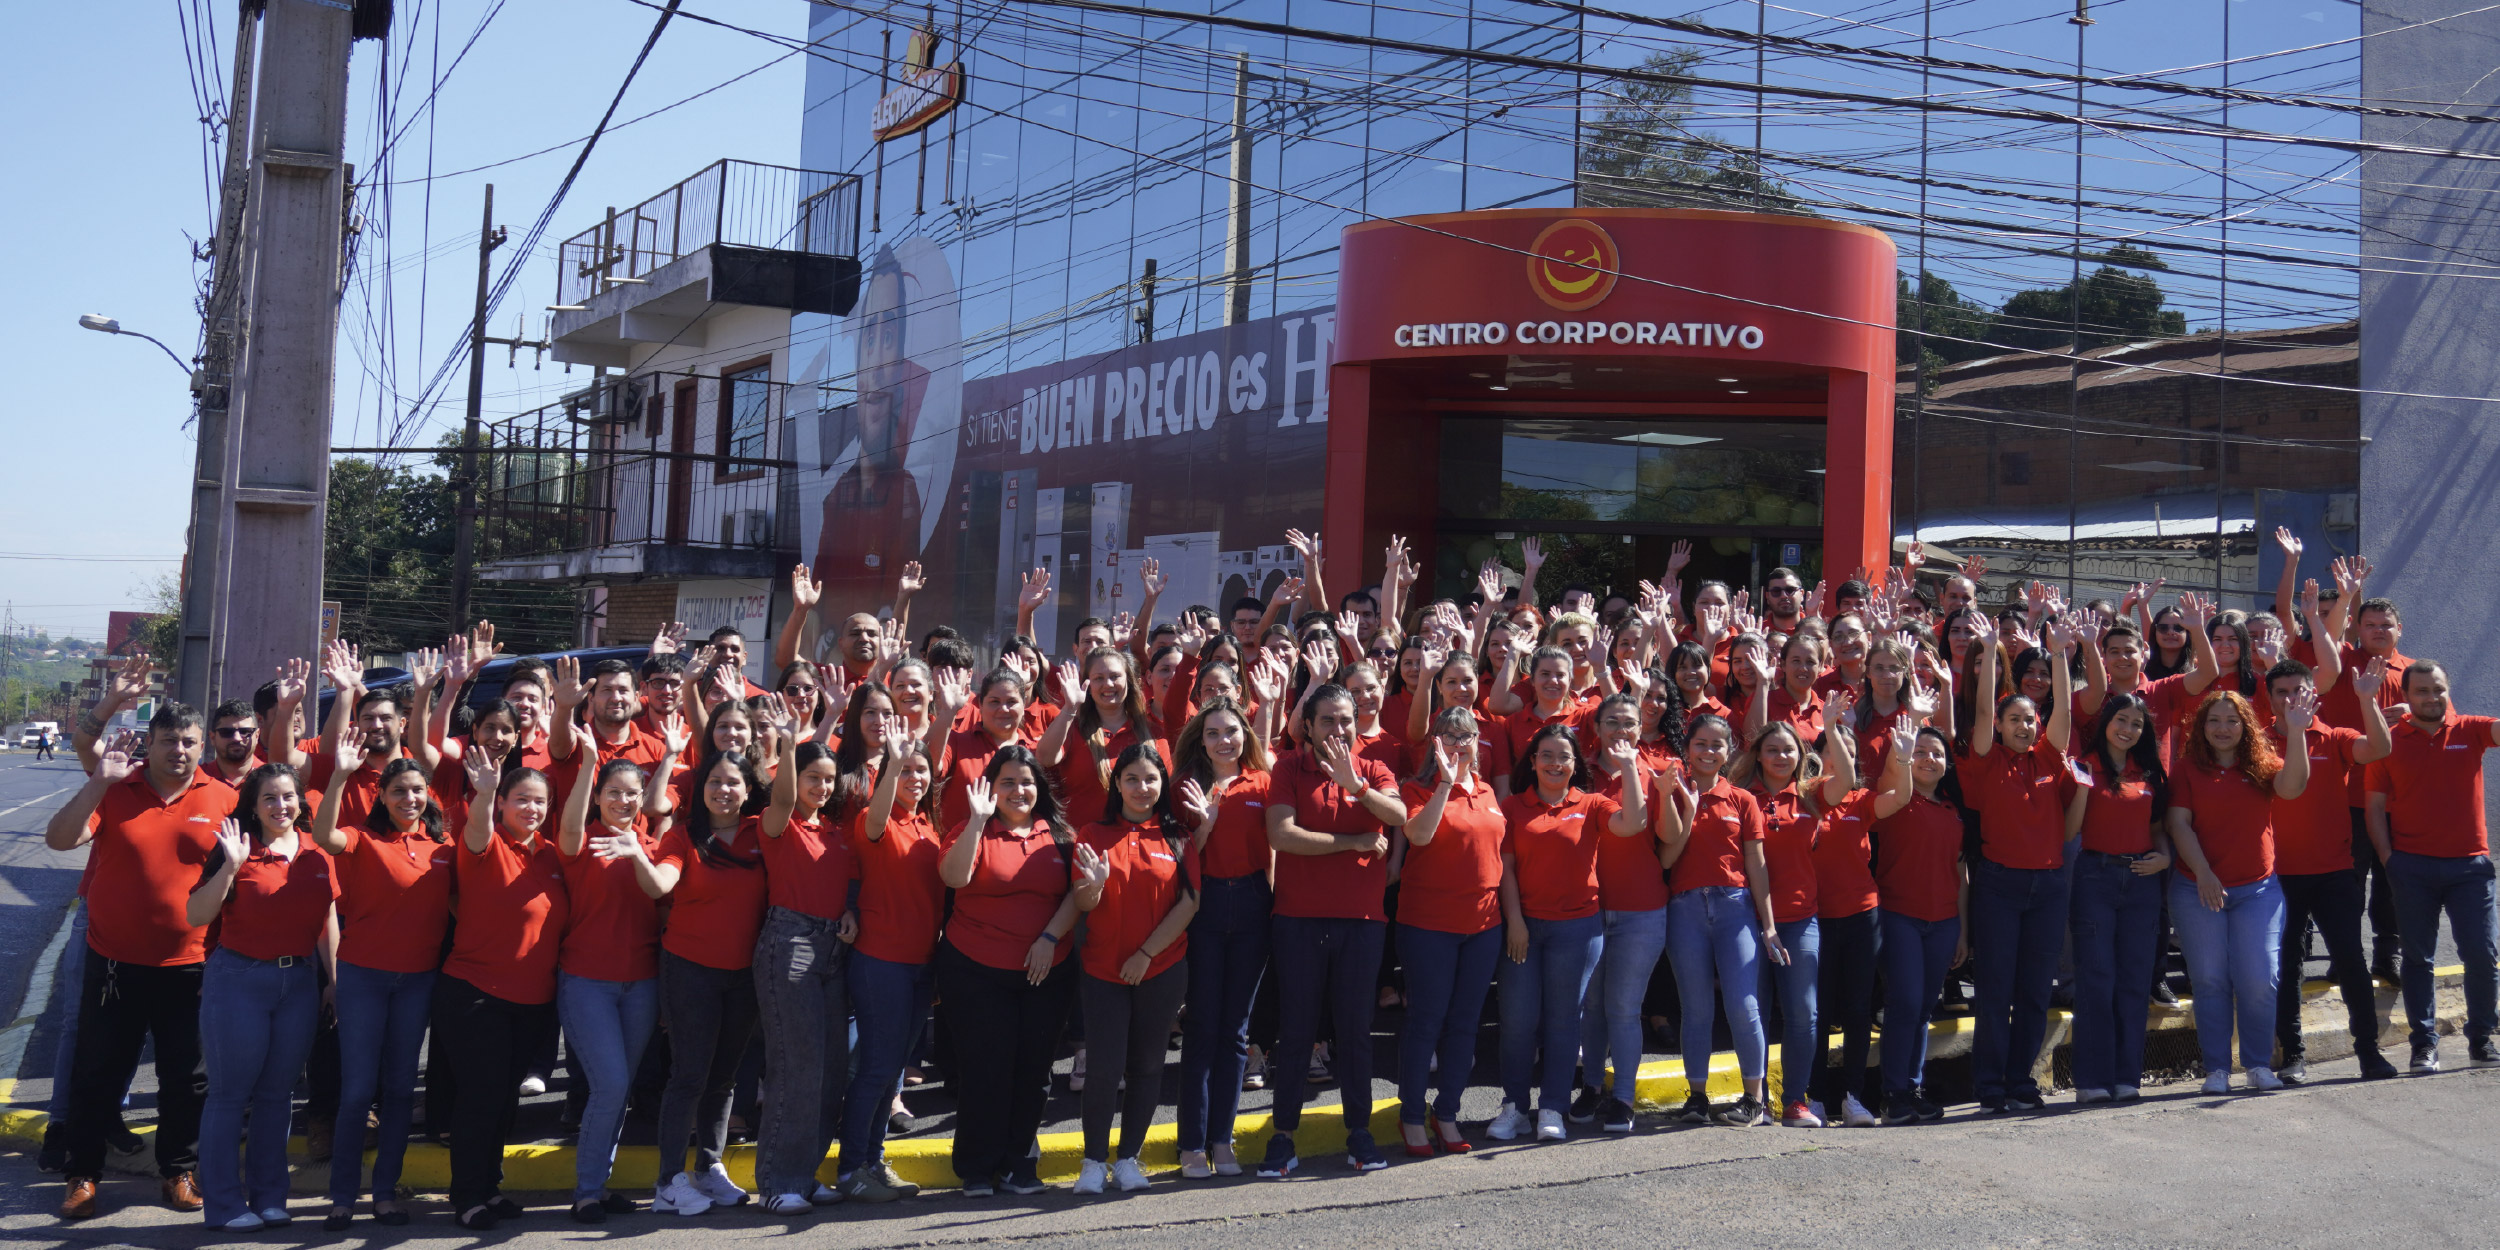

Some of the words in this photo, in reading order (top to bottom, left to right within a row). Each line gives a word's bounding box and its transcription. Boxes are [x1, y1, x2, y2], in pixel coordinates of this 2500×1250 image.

[1394, 321, 1508, 348] CENTRO
[1515, 321, 1764, 350] CORPORATIVO
[966, 414, 979, 447] SI
[981, 406, 1018, 445] TIENE
[1020, 374, 1096, 455] BUEN
[1103, 350, 1220, 443] PRECIO
[1228, 351, 1267, 414] es
[746, 596, 765, 618] ZOE
